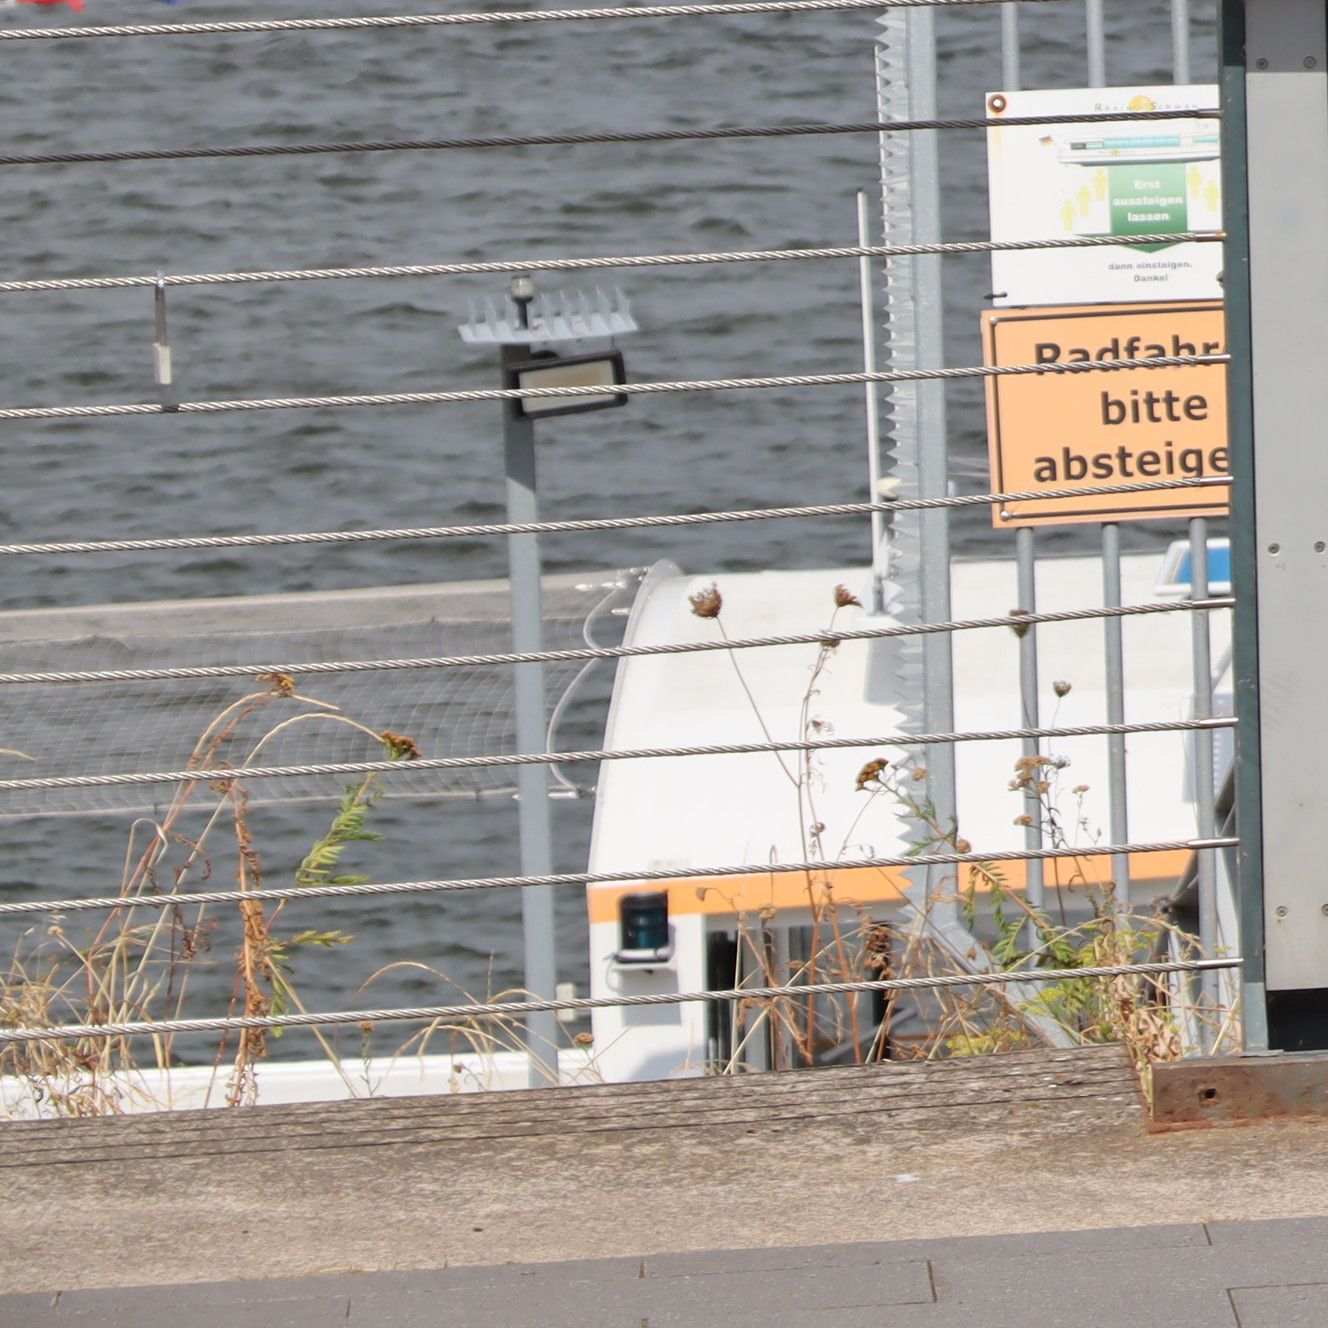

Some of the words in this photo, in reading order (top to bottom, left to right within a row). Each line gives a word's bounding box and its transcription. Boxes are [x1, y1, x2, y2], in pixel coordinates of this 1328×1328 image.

[1127, 212, 1170, 222] lassen
[1034, 334, 1225, 375] Radfahr
[1100, 389, 1208, 425] bitte
[1033, 441, 1228, 484] absteige
